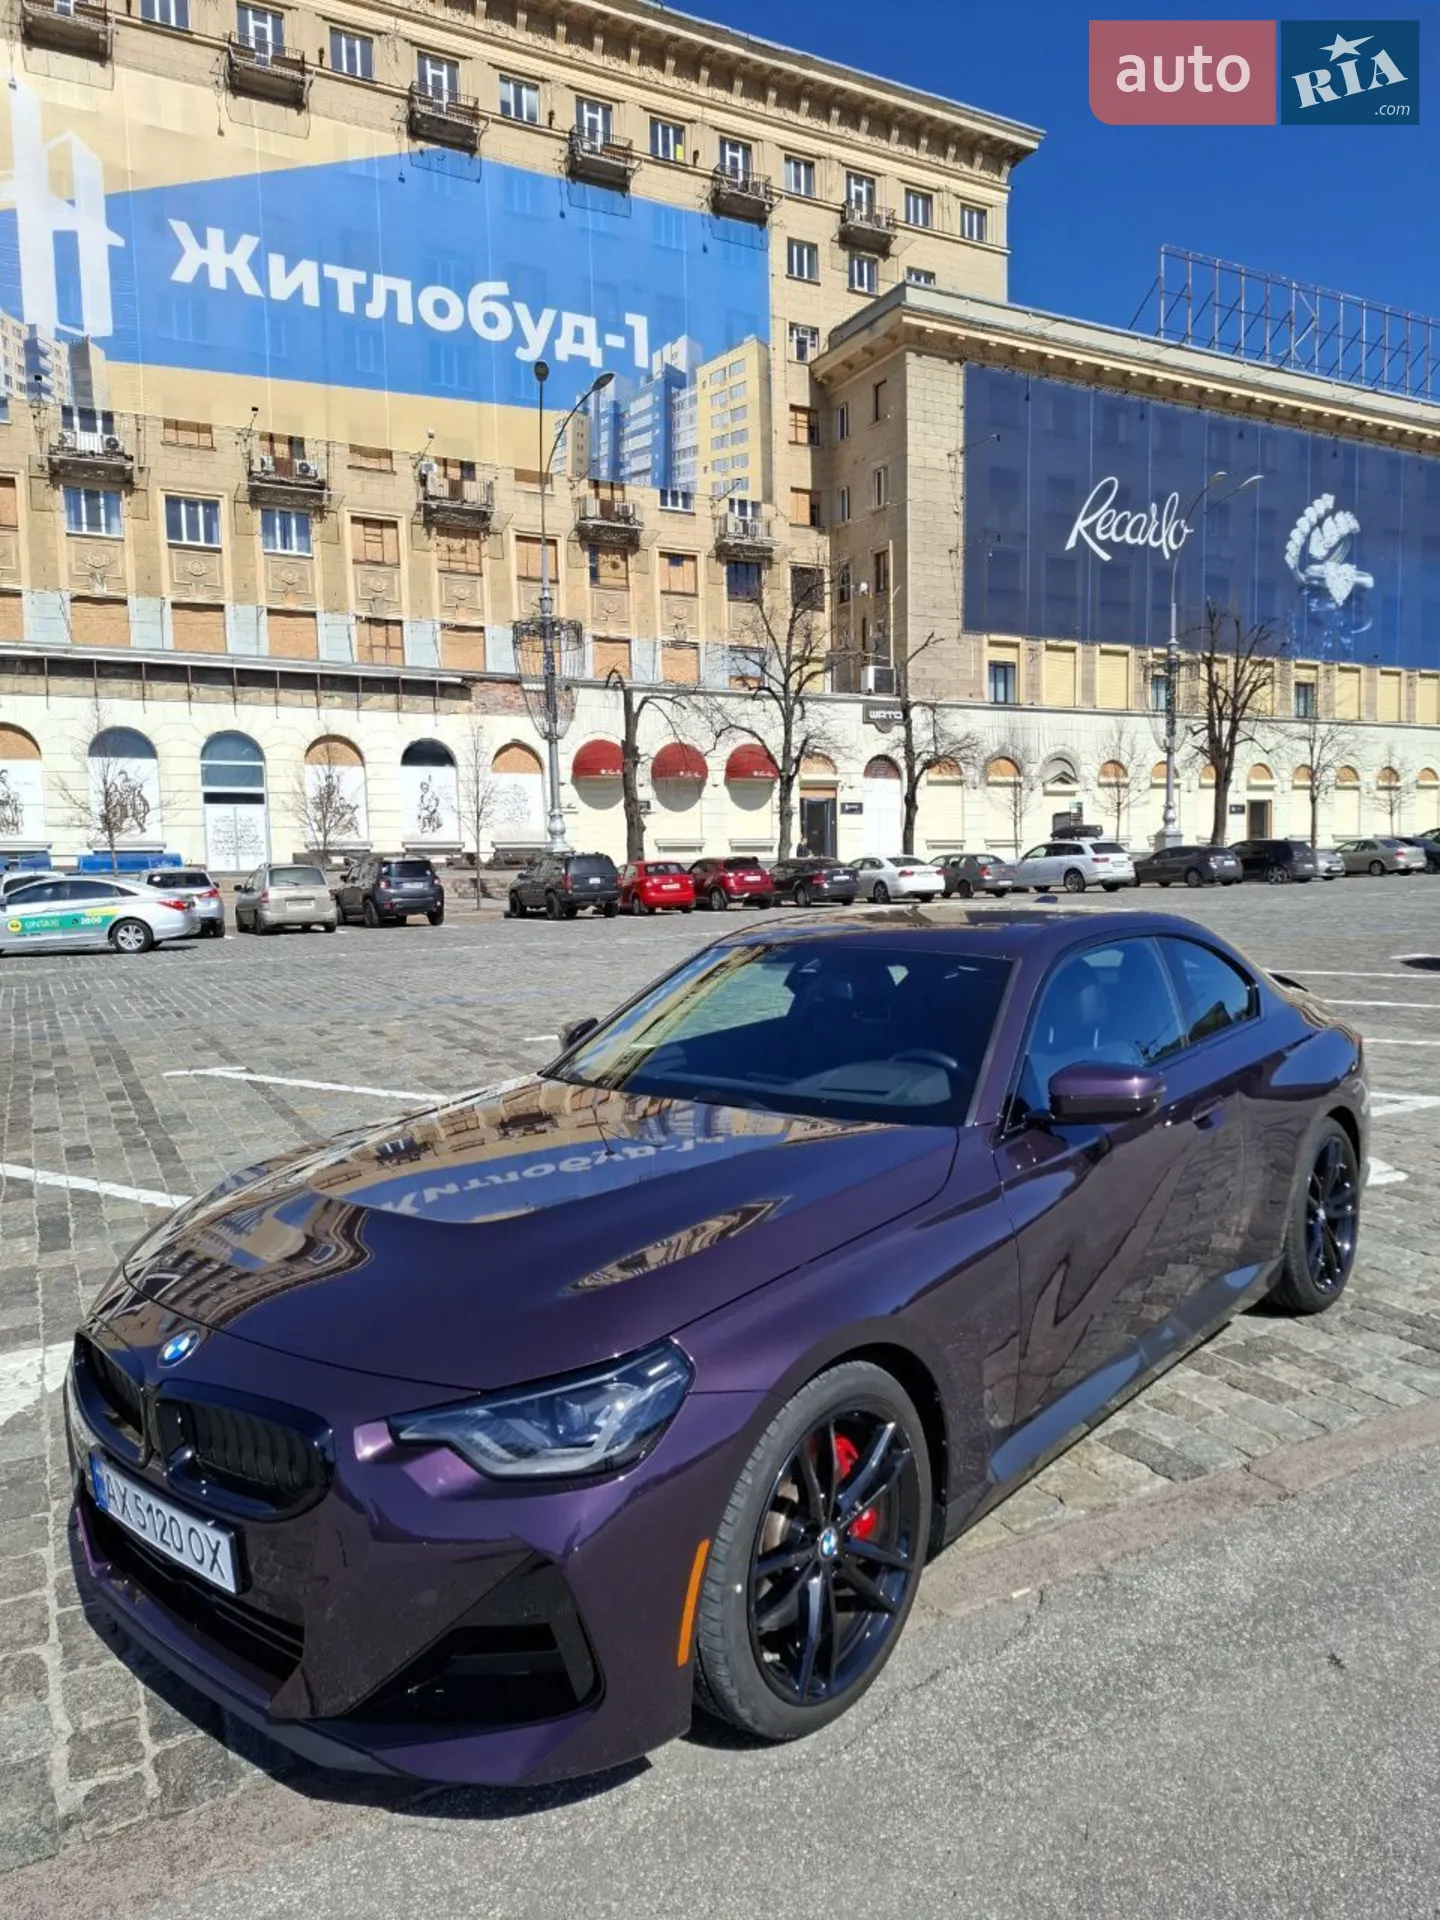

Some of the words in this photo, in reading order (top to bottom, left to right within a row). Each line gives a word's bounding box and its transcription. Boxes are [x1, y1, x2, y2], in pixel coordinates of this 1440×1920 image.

[167, 218, 649, 369] Житлобуд-1
[1064, 476, 1195, 562] Recarlo
[105, 1473, 133, 1522] AX
[133, 1493, 184, 1554] 5120
[188, 1526, 226, 1581] OX
